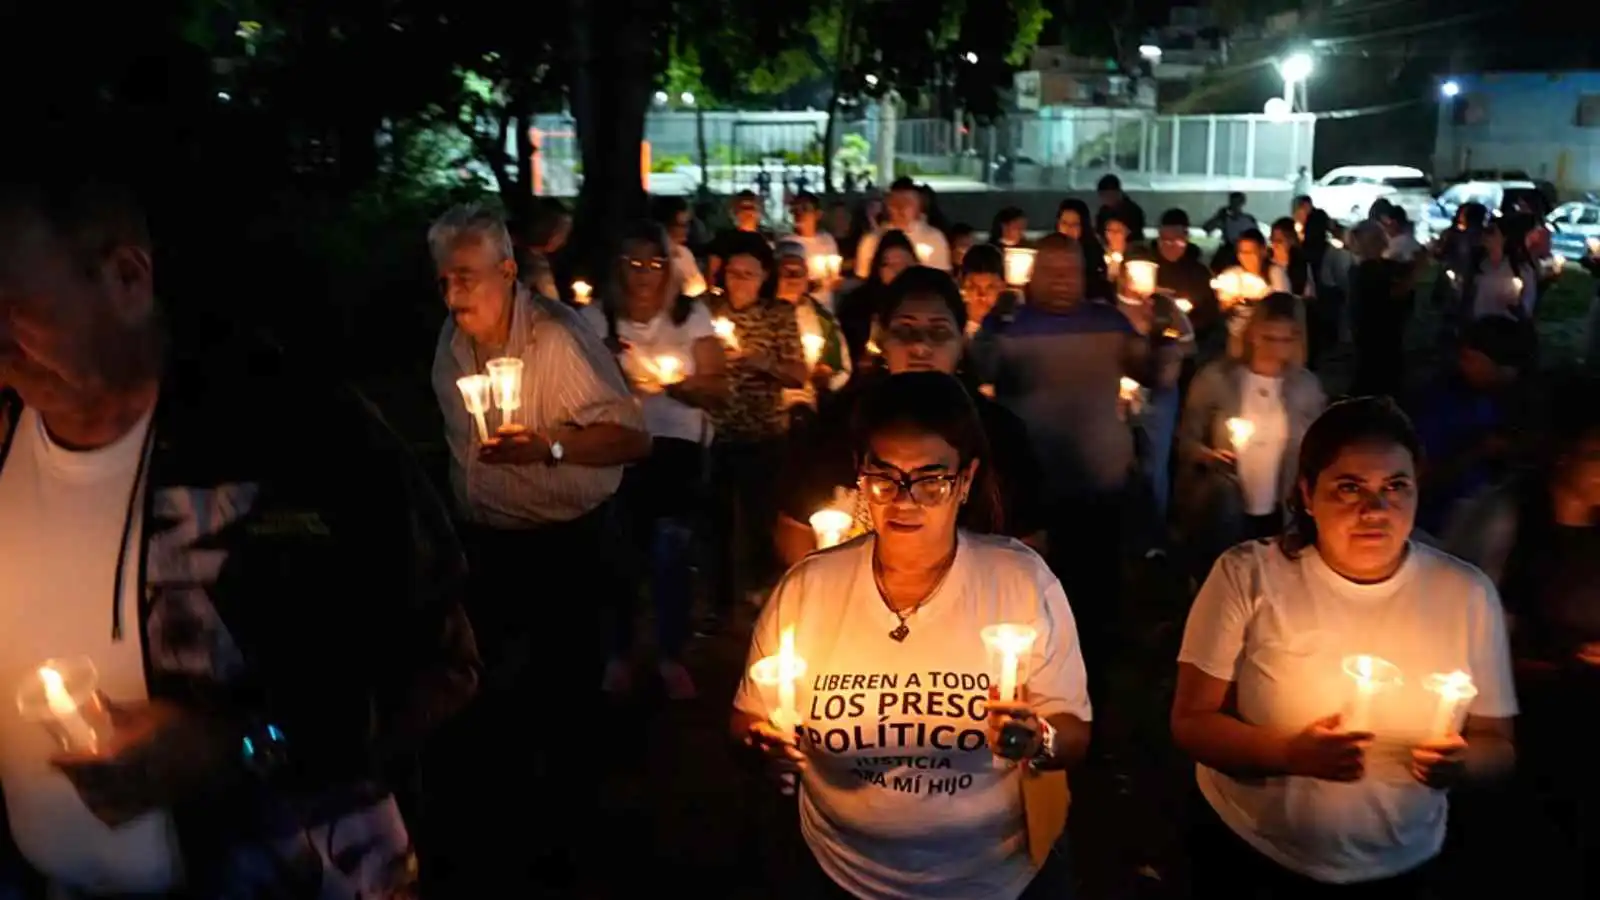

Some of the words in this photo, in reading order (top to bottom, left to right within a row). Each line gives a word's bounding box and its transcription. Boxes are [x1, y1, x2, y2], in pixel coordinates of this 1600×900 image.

[813, 673, 898, 691] LIBEREN
[905, 673, 921, 689] A
[928, 671, 990, 691] TODO
[811, 694, 865, 720] LOS
[878, 692, 989, 721] PRESO
[807, 717, 989, 752] POLÍTICO
[894, 774, 921, 794] MÍ
[928, 773, 973, 796] HIJO
